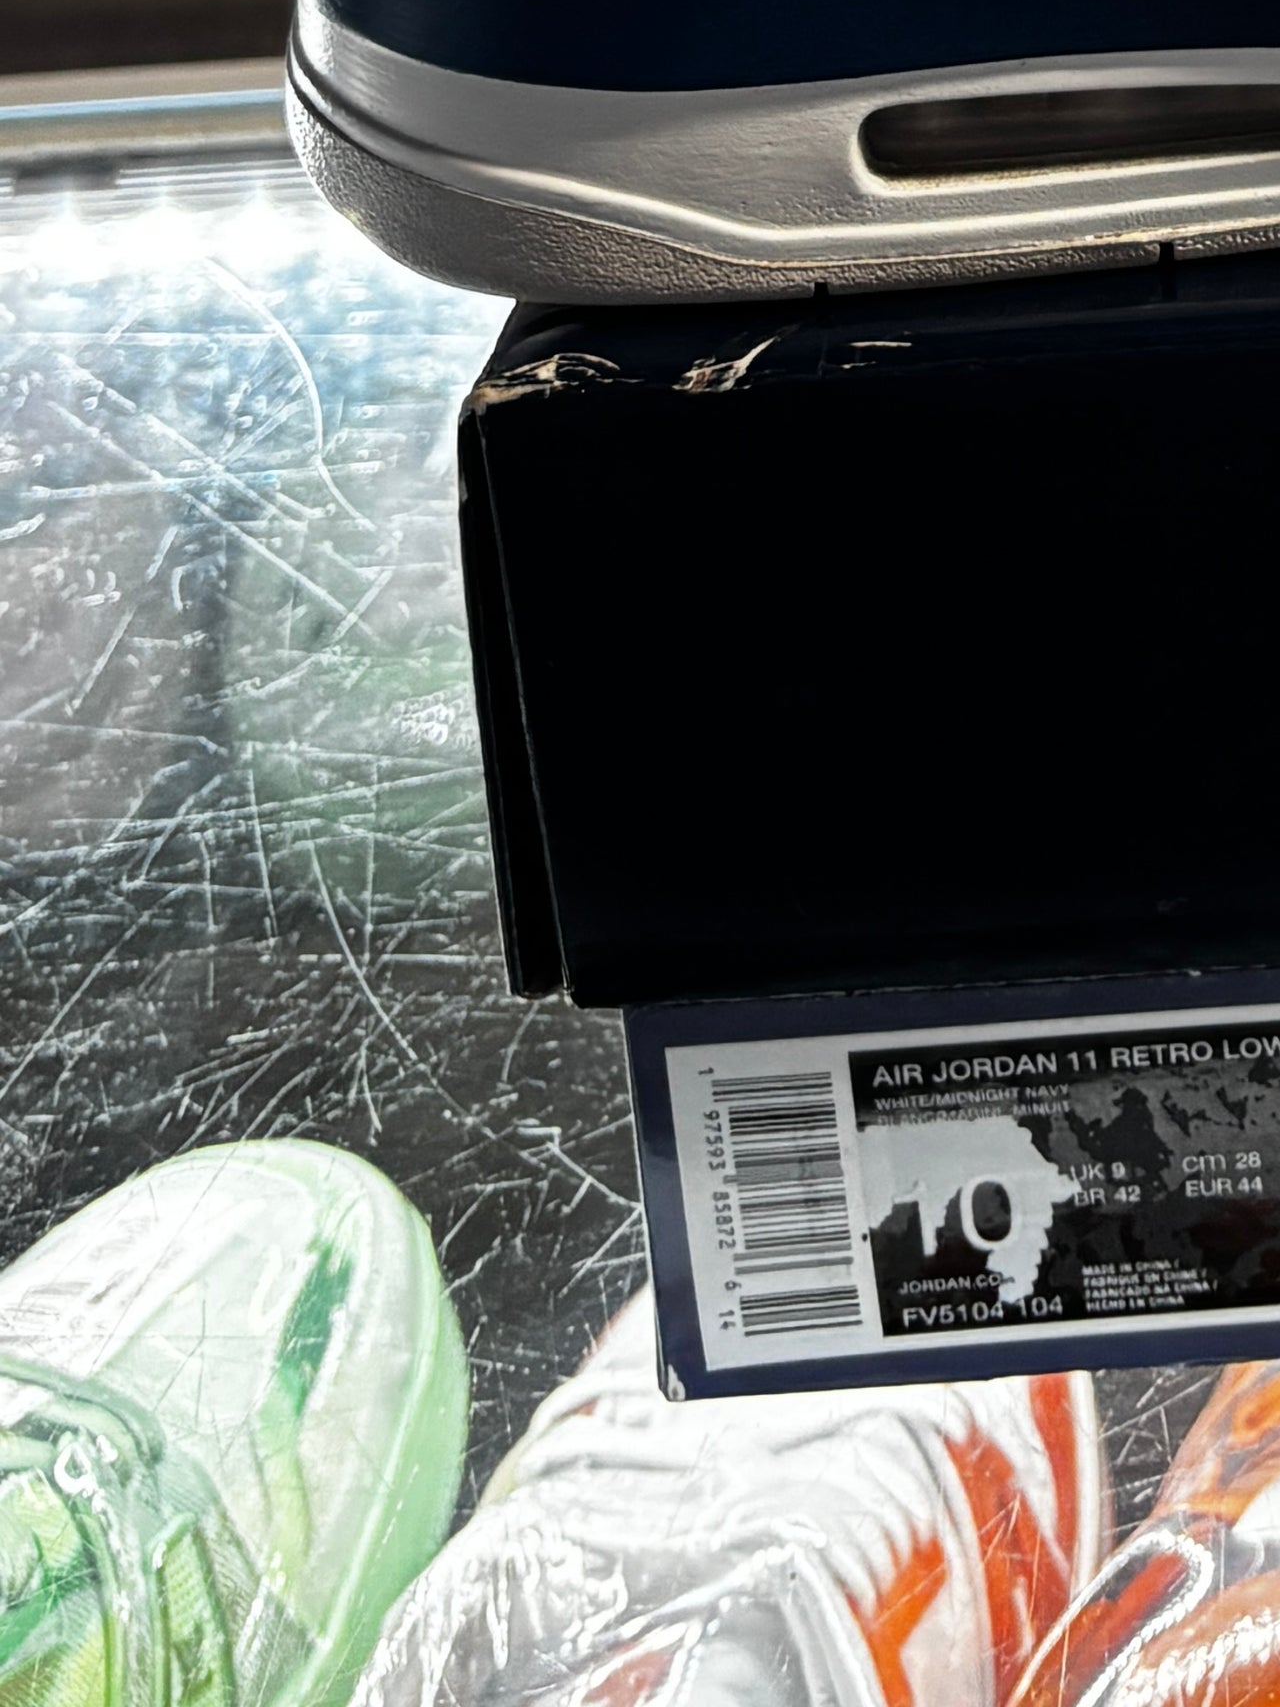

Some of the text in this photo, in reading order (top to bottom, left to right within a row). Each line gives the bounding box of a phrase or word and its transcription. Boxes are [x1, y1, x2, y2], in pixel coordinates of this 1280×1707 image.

[697, 1066, 715, 1076] 1
[872, 1063, 924, 1089] AIR
[931, 1052, 1058, 1084] JORDAN
[1066, 1050, 1098, 1072] 11
[1110, 1040, 1214, 1069] RETRO
[1024, 1083, 1070, 1099] NAVY
[1012, 1099, 1071, 1117] MINUIT
[702, 1108, 727, 1171] 97593
[1069, 1160, 1127, 1182] UK 9
[1234, 1150, 1263, 1170] 28
[1073, 1184, 1142, 1207] BR 42
[1184, 1175, 1264, 1199] EUR 44
[711, 1190, 737, 1250] 85872
[891, 1173, 1023, 1258] 10
[902, 1294, 1063, 1329] FV5104 104
